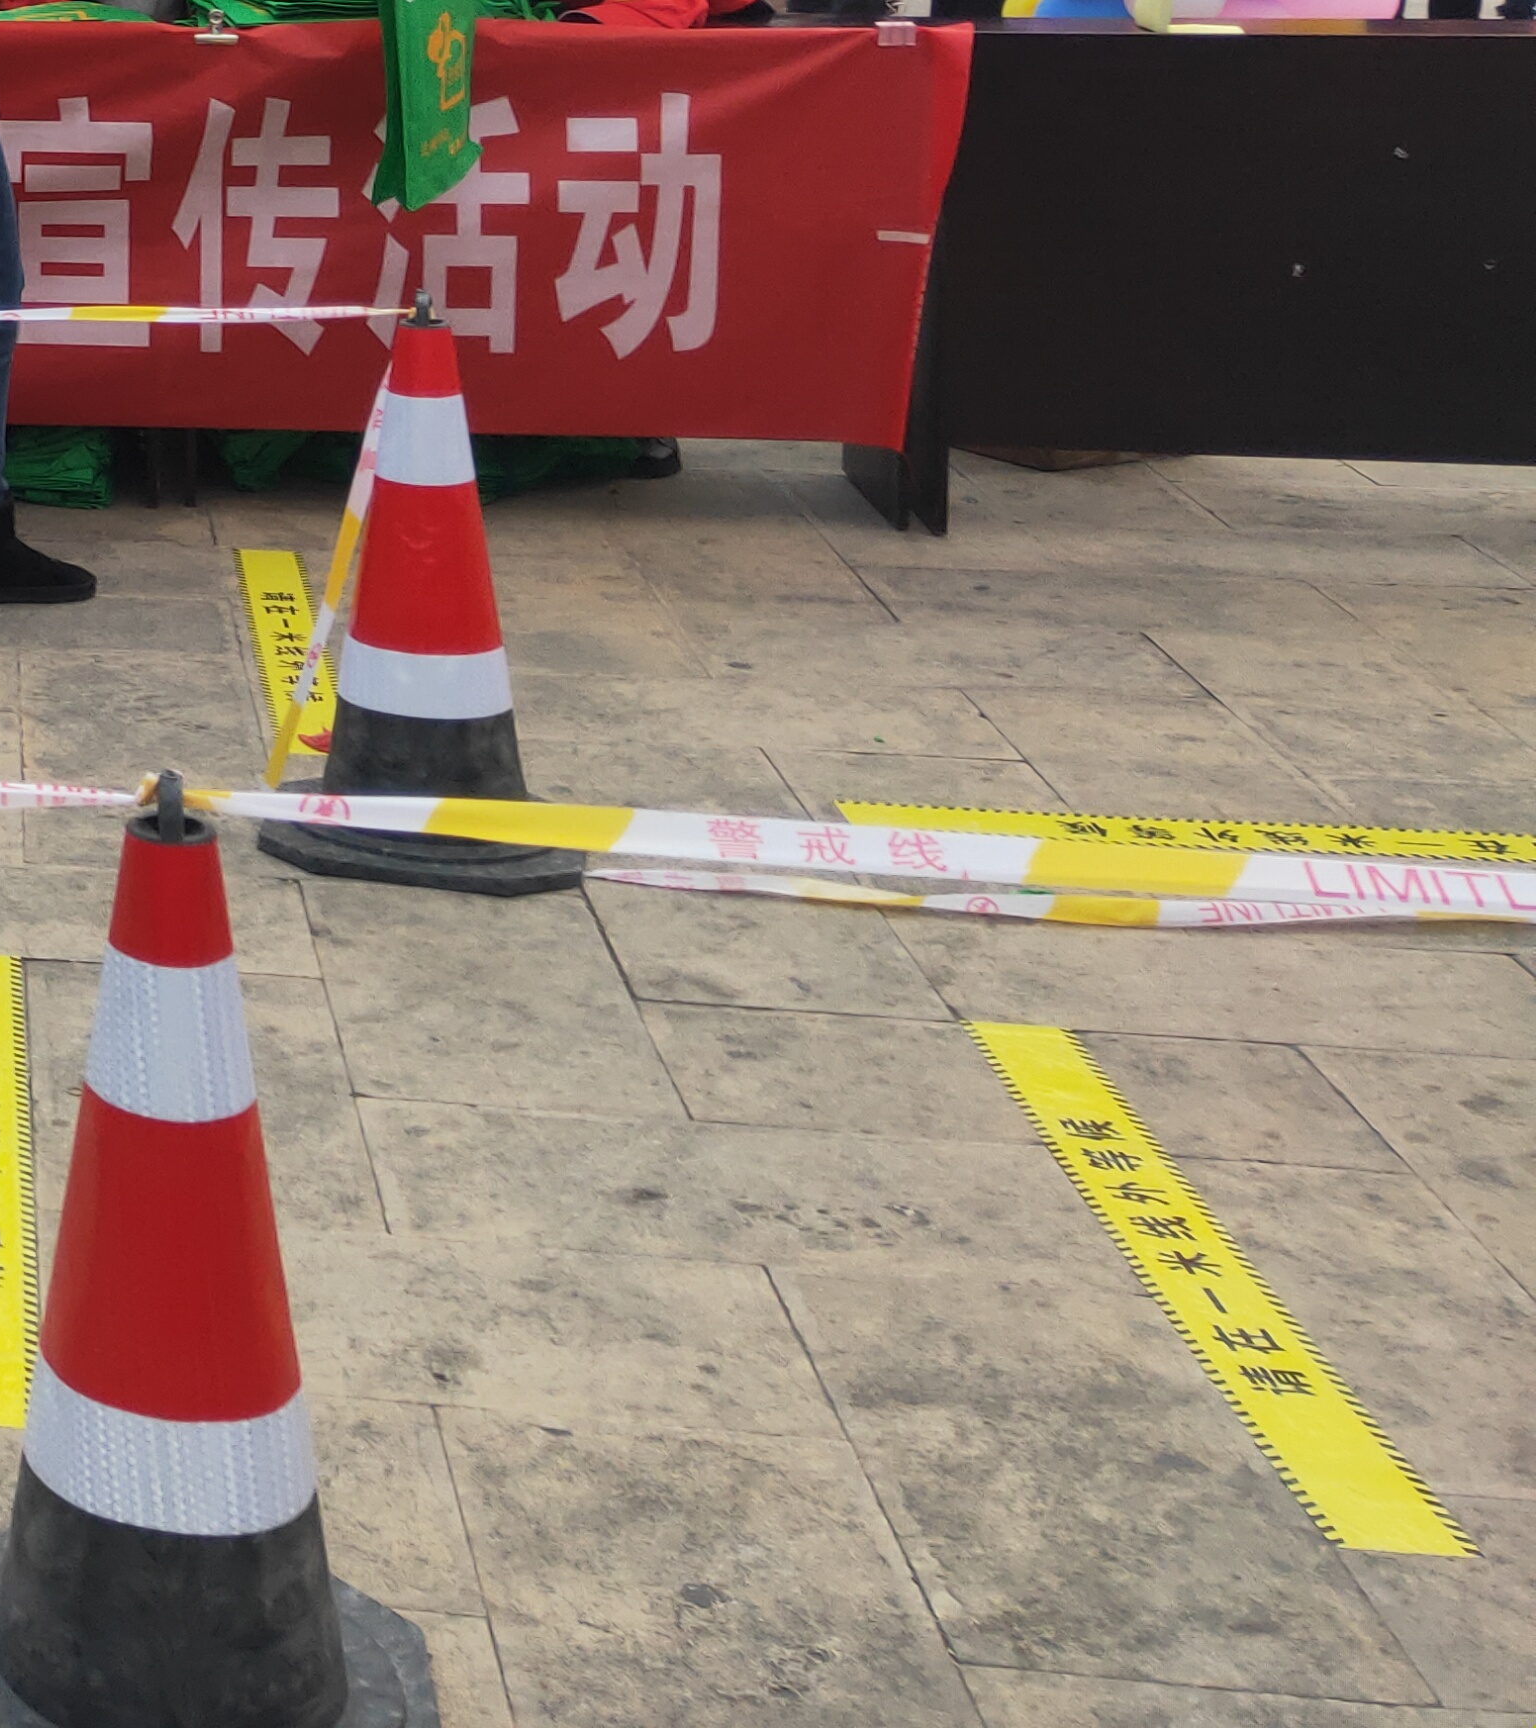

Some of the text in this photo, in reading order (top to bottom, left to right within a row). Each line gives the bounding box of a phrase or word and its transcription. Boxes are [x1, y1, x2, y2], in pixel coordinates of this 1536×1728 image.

[707, 816, 948, 873] 警戒线
[1058, 1117, 1317, 1397] 请在一米线外等候
